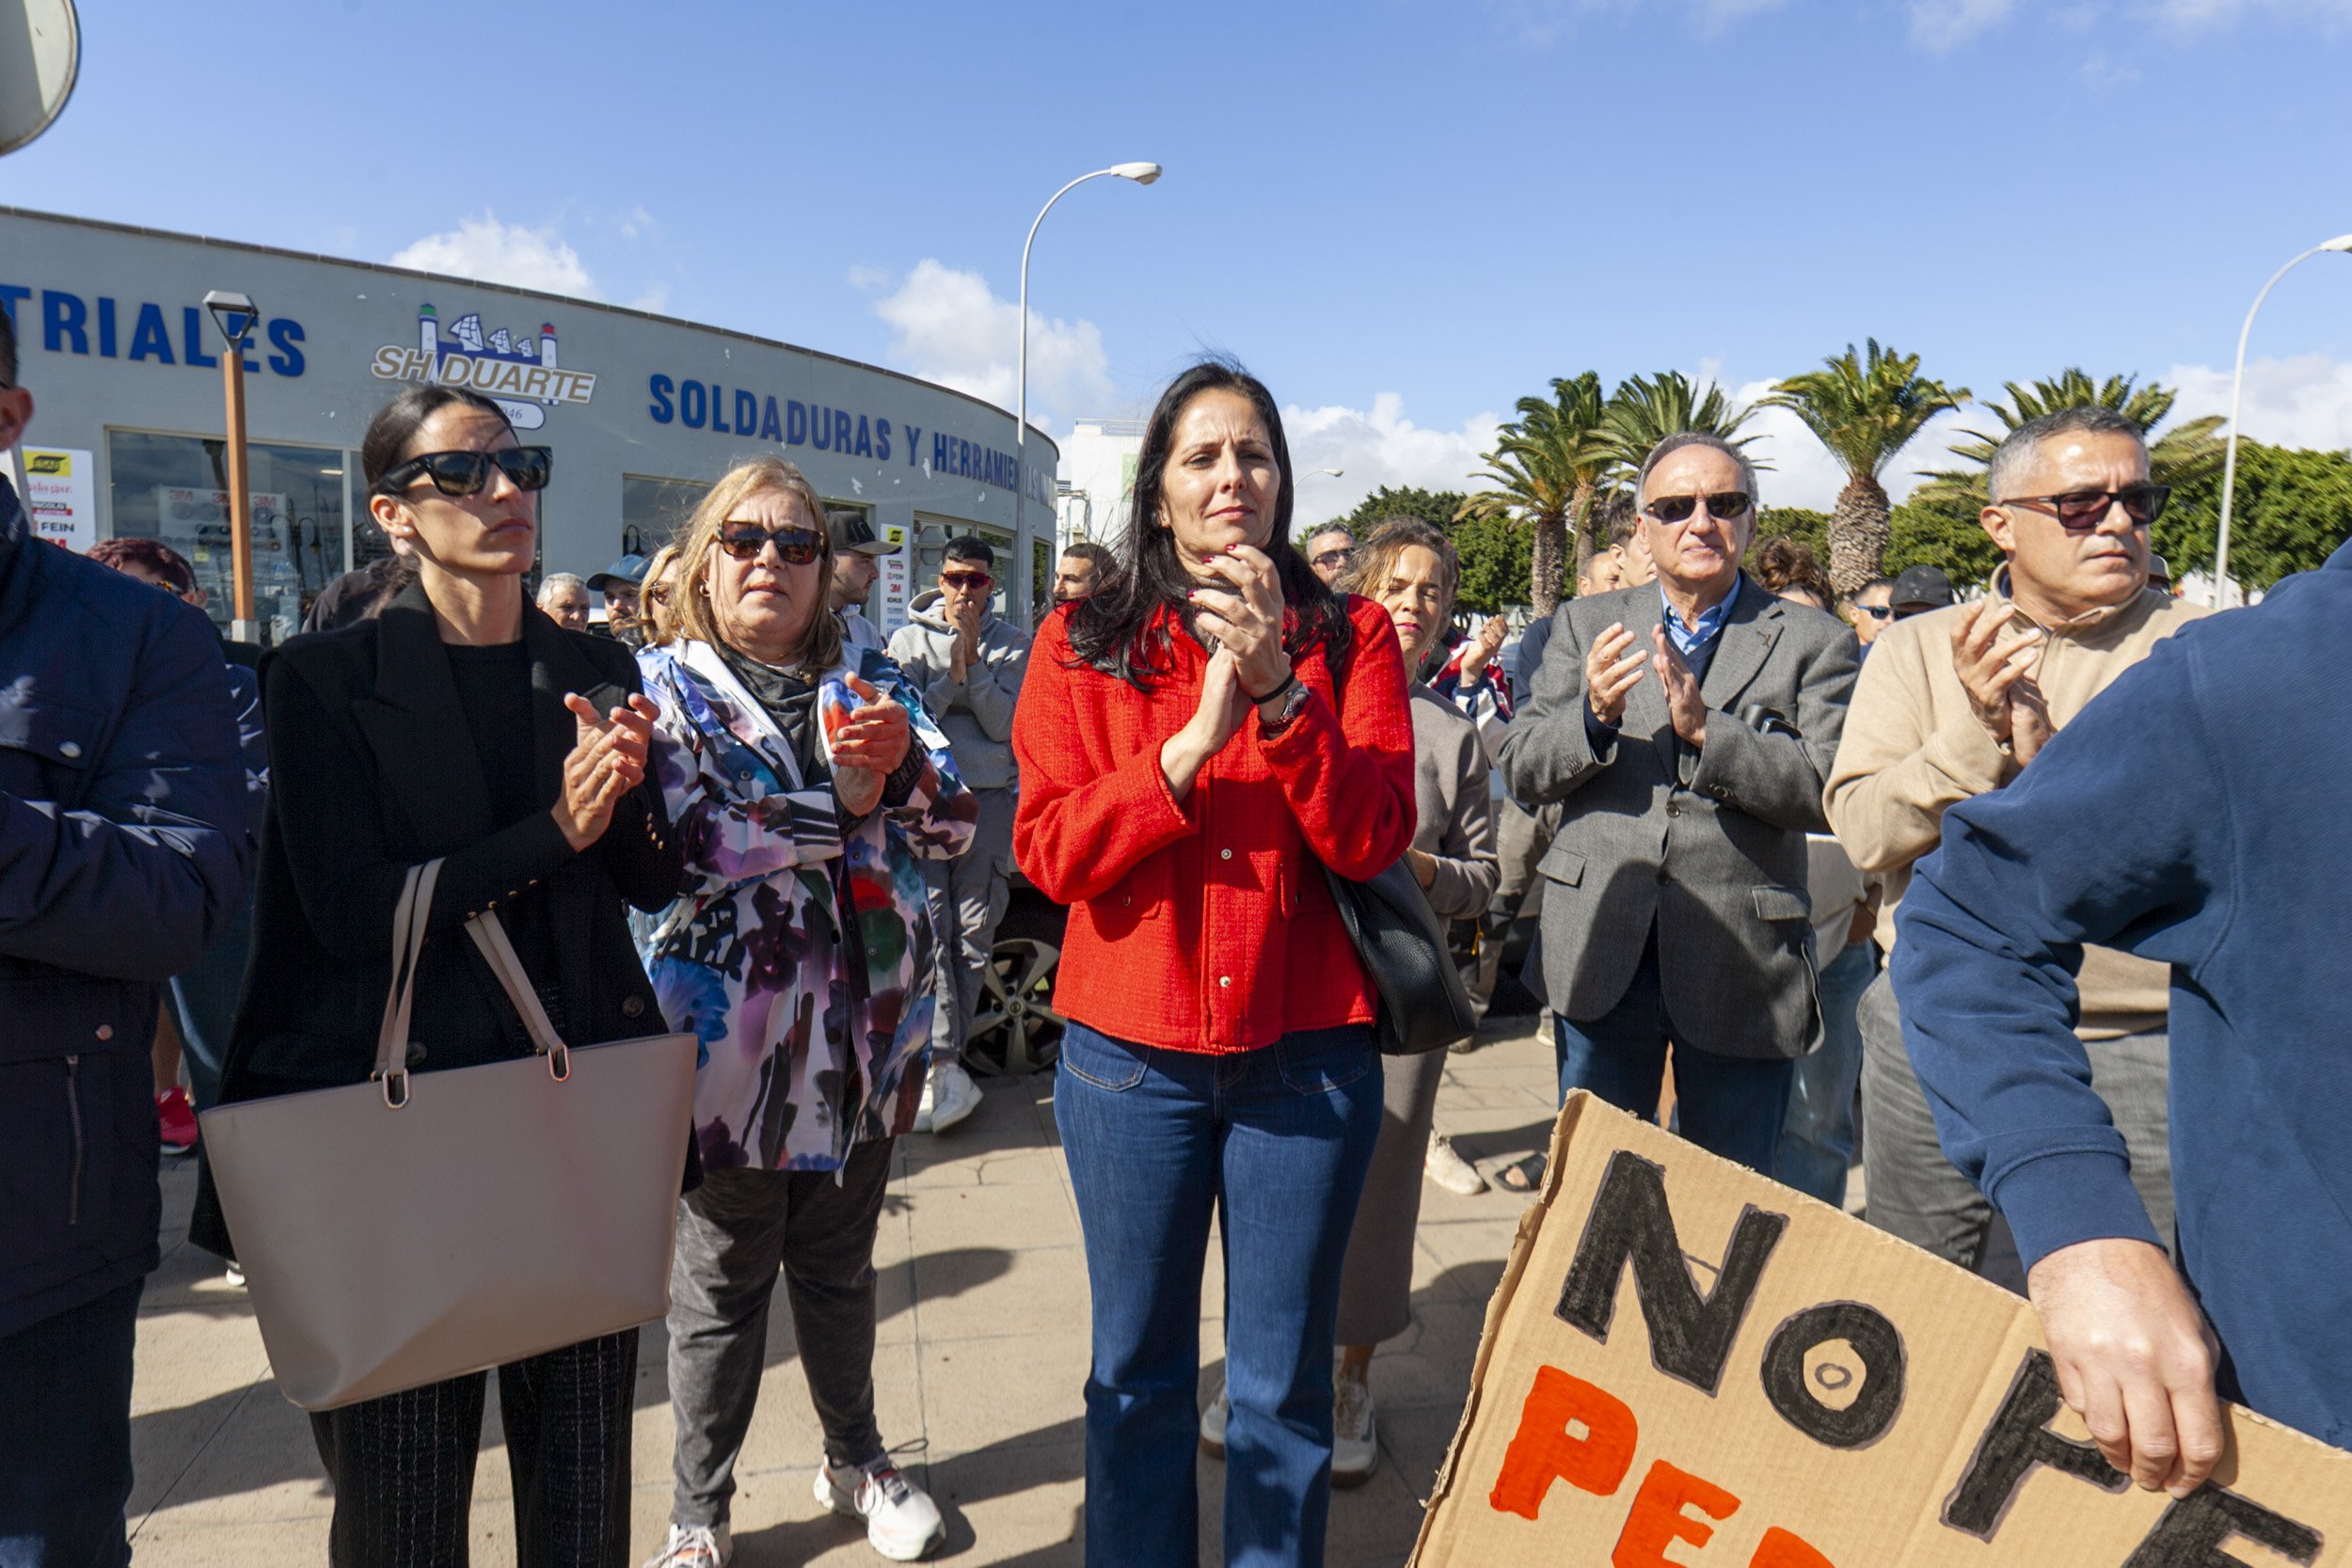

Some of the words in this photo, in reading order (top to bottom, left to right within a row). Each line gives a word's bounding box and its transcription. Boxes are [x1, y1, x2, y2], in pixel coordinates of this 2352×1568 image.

[372, 345, 436, 380] SH
[439, 354, 596, 403] DUARTE
[649, 373, 891, 461] SOLDADURAS
[905, 425, 922, 467] Y
[41, 522, 75, 532] FEIN
[890, 583, 900, 593] 3M
[1554, 1148, 1909, 1451] NO
[1489, 1365, 1836, 1568] PE
